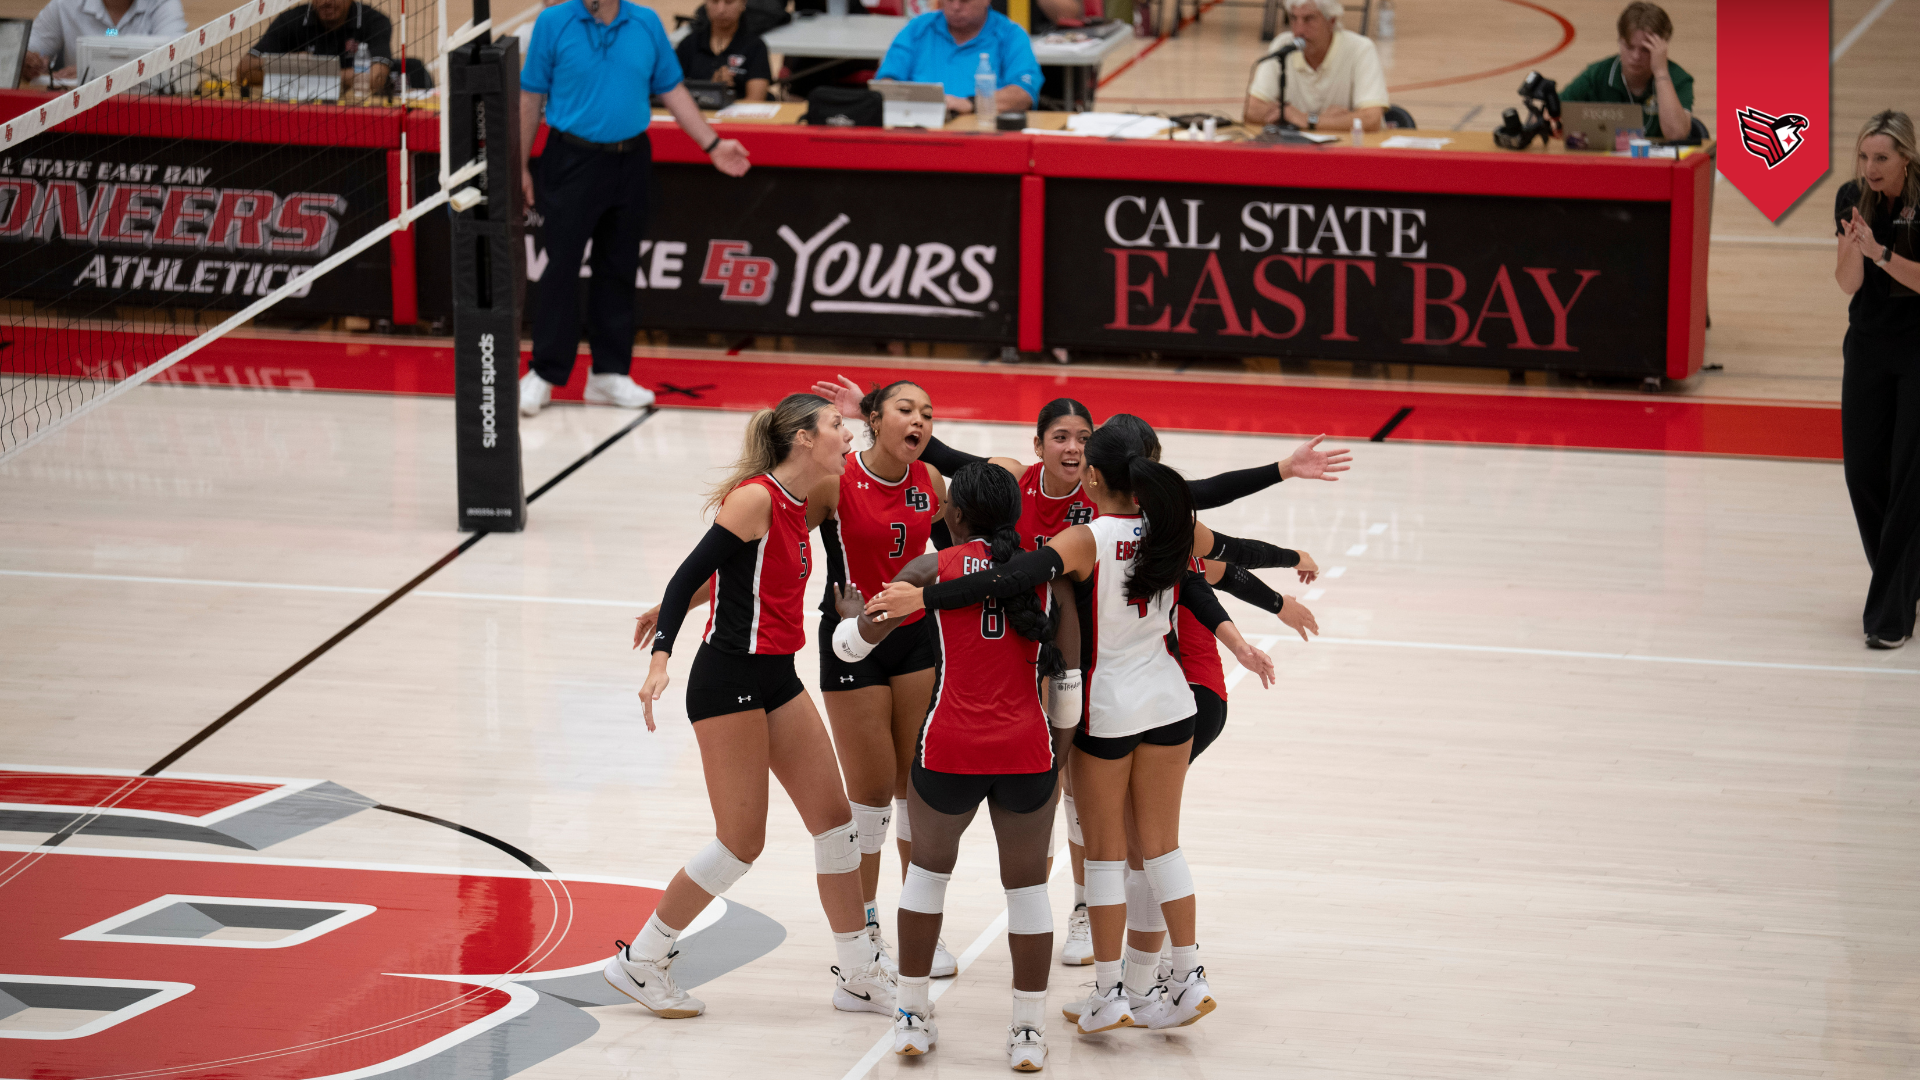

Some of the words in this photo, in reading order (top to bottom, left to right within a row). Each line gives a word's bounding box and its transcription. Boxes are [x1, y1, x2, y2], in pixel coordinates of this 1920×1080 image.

[20, 158, 93, 179] STATE
[97, 161, 159, 183] EAST
[162, 165, 212, 185] BAY
[1104, 195, 1221, 251] CAL
[1240, 201, 1428, 258] STATE
[699, 238, 778, 304] EB
[777, 213, 997, 317] YOURS
[1103, 247, 1377, 342] EAST
[1400, 260, 1601, 352] BAY
[478, 333, 497, 385] sports
[478, 386, 499, 449] imports
[905, 486, 931, 512] EB
[798, 542, 808, 579] 5
[888, 522, 907, 558] 3
[980, 597, 1006, 640] 8
